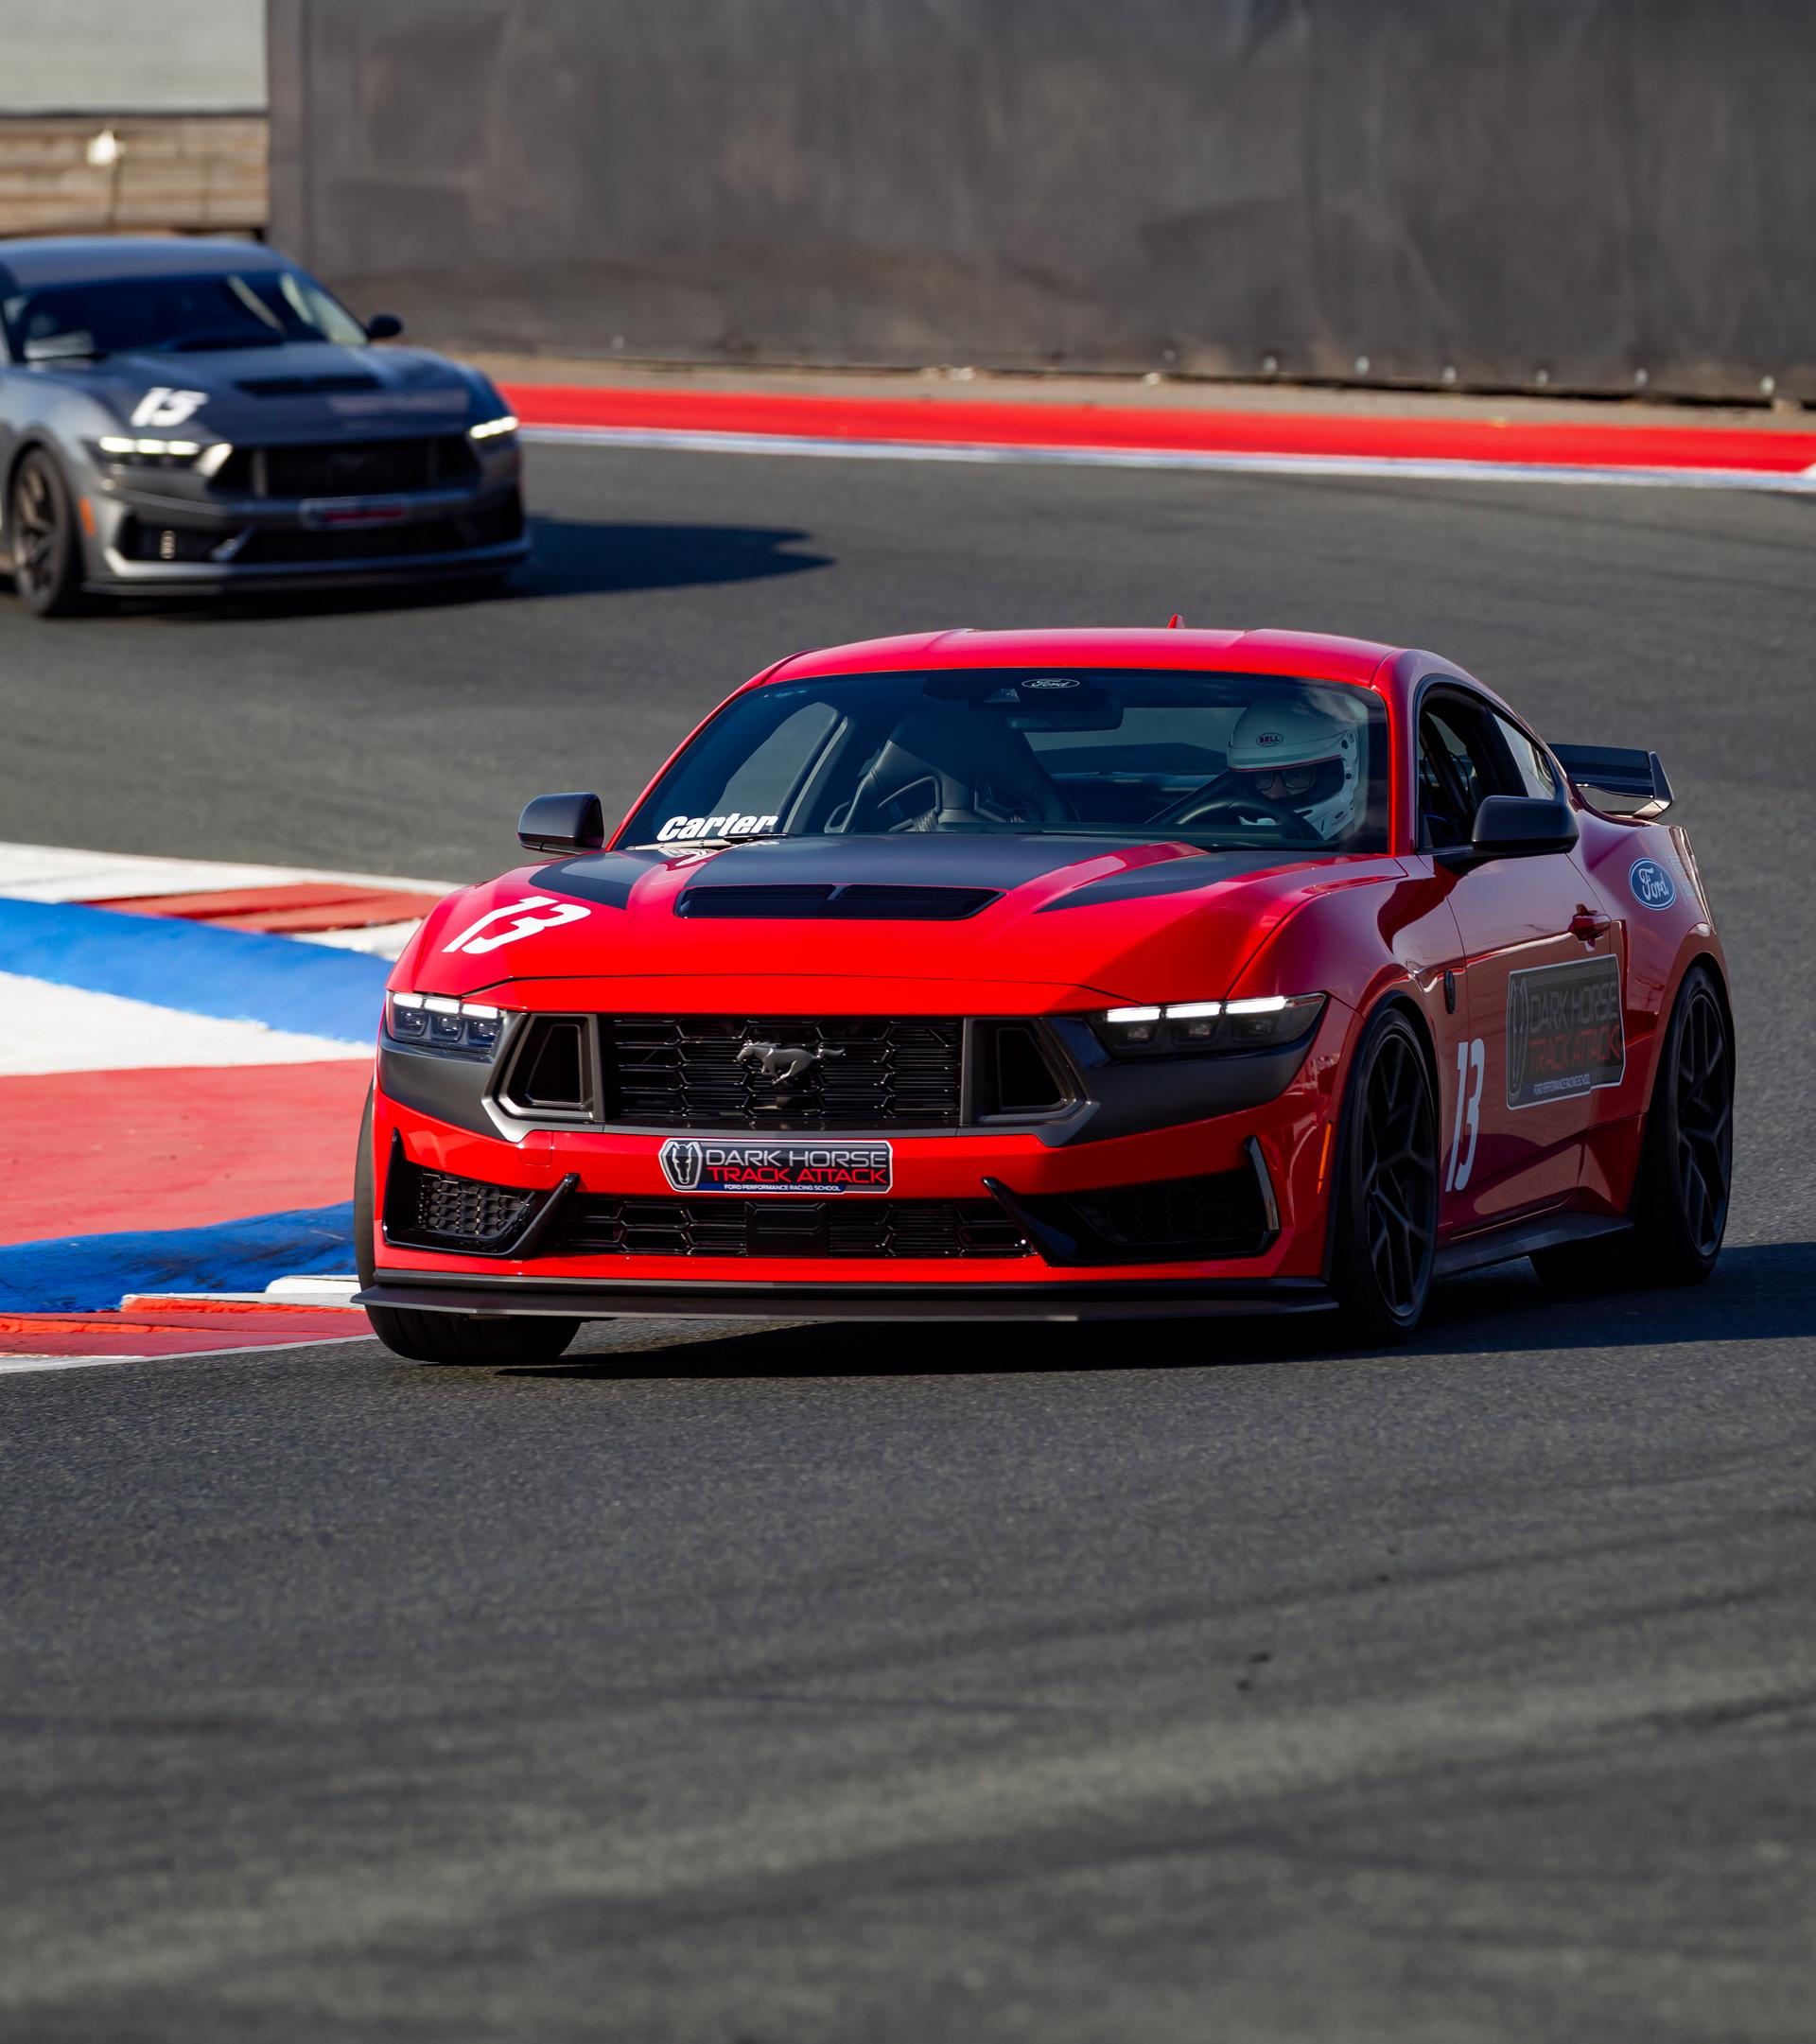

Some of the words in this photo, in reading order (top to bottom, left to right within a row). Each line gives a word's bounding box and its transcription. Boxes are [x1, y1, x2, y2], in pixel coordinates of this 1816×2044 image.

[1259, 735, 1281, 743] BELL
[656, 812, 779, 842] Carter
[1638, 867, 1669, 901] Ford
[441, 895, 592, 954] 13
[1529, 989, 1568, 1034] DARK
[1571, 981, 1618, 1026] HORSE
[1528, 1034, 1571, 1073] TRACK
[1571, 1024, 1621, 1068] ATTACK
[1445, 1038, 1485, 1192] 13
[706, 1149, 782, 1167] DARK
[788, 1151, 887, 1168] HORSE
[707, 1167, 790, 1182] TRACK
[796, 1168, 887, 1183] ATTACK
